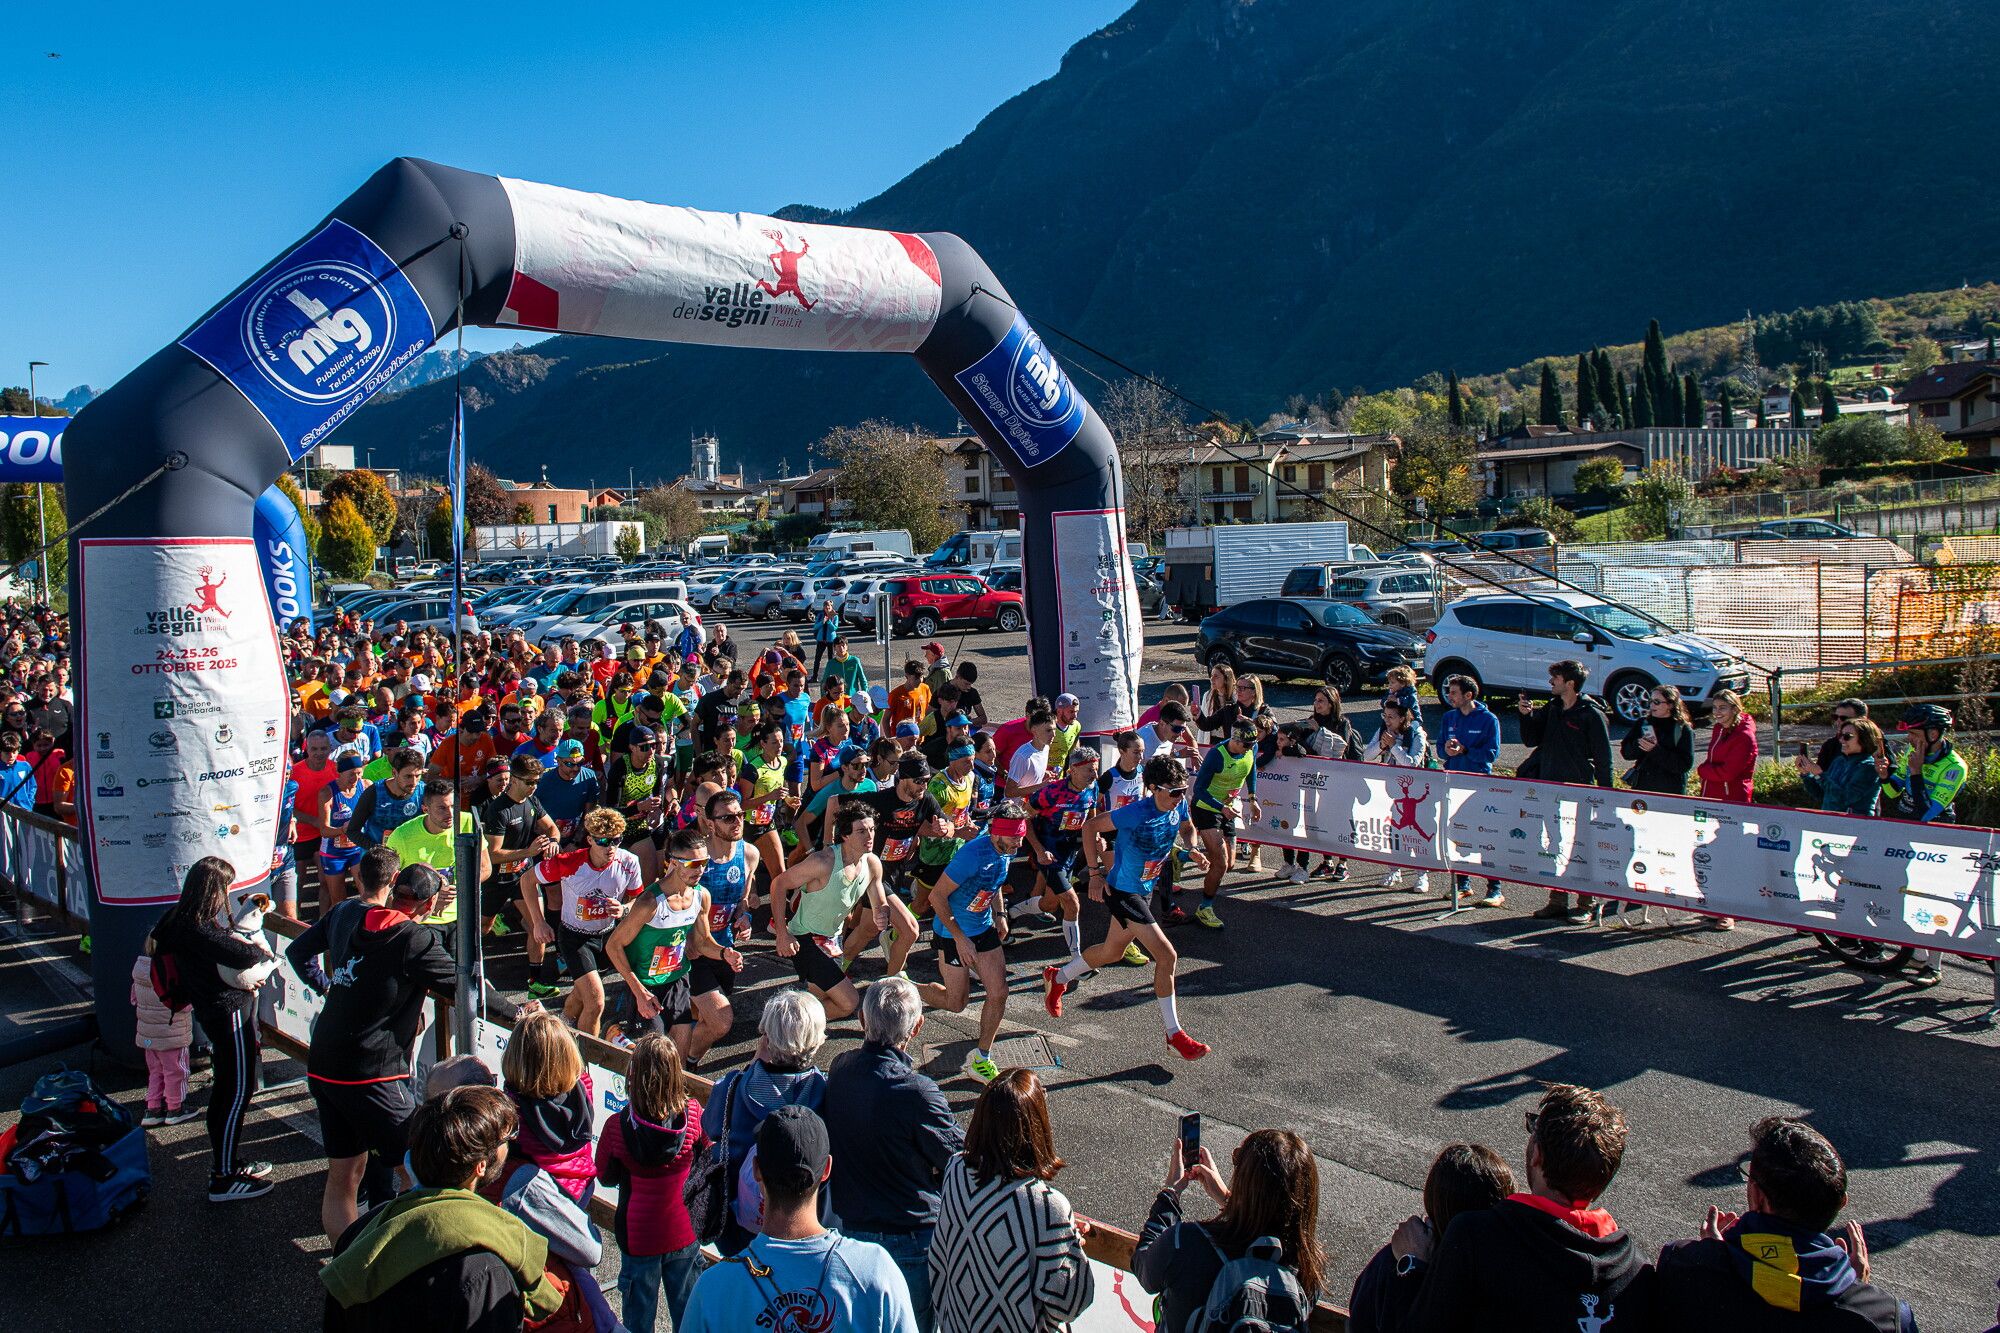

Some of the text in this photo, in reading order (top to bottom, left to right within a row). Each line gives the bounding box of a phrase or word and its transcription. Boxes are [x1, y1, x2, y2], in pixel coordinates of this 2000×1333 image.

[704, 282, 764, 309] valle
[255, 273, 361, 362] Manifattura Tessile Gelmi
[699, 304, 772, 329] segni
[774, 304, 801, 316] Wine
[771, 316, 803, 328] Trail.it
[278, 328, 302, 350] NEW
[354, 345, 382, 370] 732090
[300, 339, 426, 449] Stampa Digitale
[971, 372, 1041, 458] Stampa Digitale
[146, 607, 195, 623] valle
[147, 617, 202, 637] segni
[156, 647, 219, 660] 24.25.26
[131, 658, 238, 675] OTTOBRE 2025
[176, 701, 212, 710] Regione
[176, 706, 221, 716] Lombardia
[198, 767, 245, 782] BROOKS
[252, 764, 275, 774] LAND
[1256, 771, 1290, 782] BROOKS
[1302, 779, 1326, 787] LAND
[1348, 817, 1393, 836] valle
[1350, 832, 1400, 852] segni
[1402, 834, 1422, 845] Wine
[1884, 847, 1949, 864] BROOKS
[587, 907, 605, 916] 148
[712, 914, 724, 924] 54
